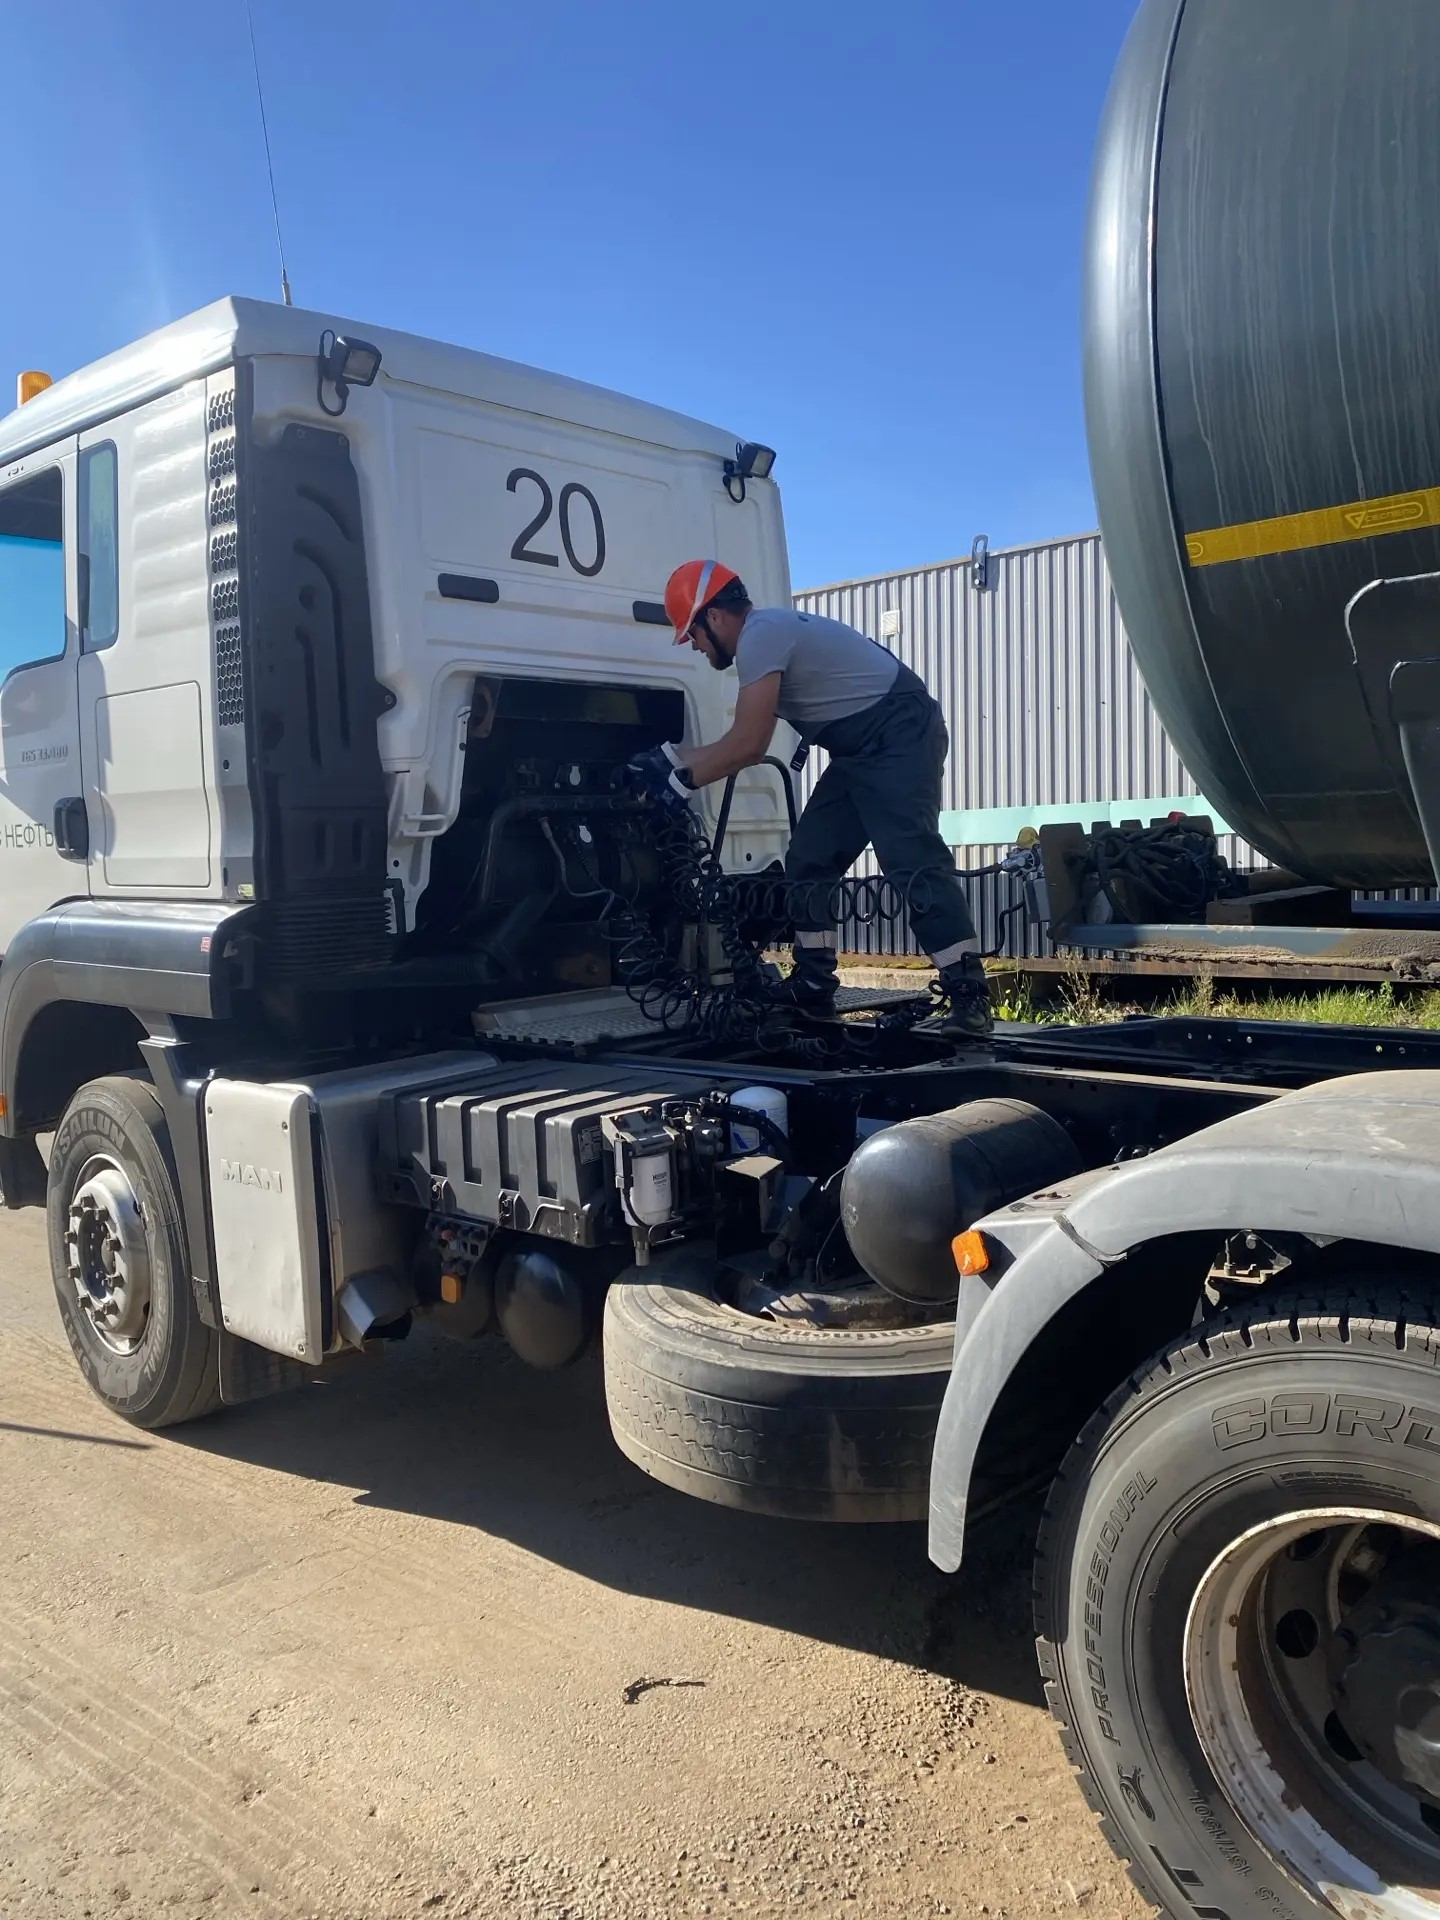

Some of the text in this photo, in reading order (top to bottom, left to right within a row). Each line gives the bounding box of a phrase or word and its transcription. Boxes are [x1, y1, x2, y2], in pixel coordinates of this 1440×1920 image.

[506, 467, 606, 577] 20
[0, 823, 54, 848] НЕФТЬ
[60, 1110, 126, 1154] SAILUN
[220, 1158, 283, 1194] MAN
[143, 1258, 168, 1382] REGIONAL
[1084, 1470, 1158, 1747] PROFESSIONAL
